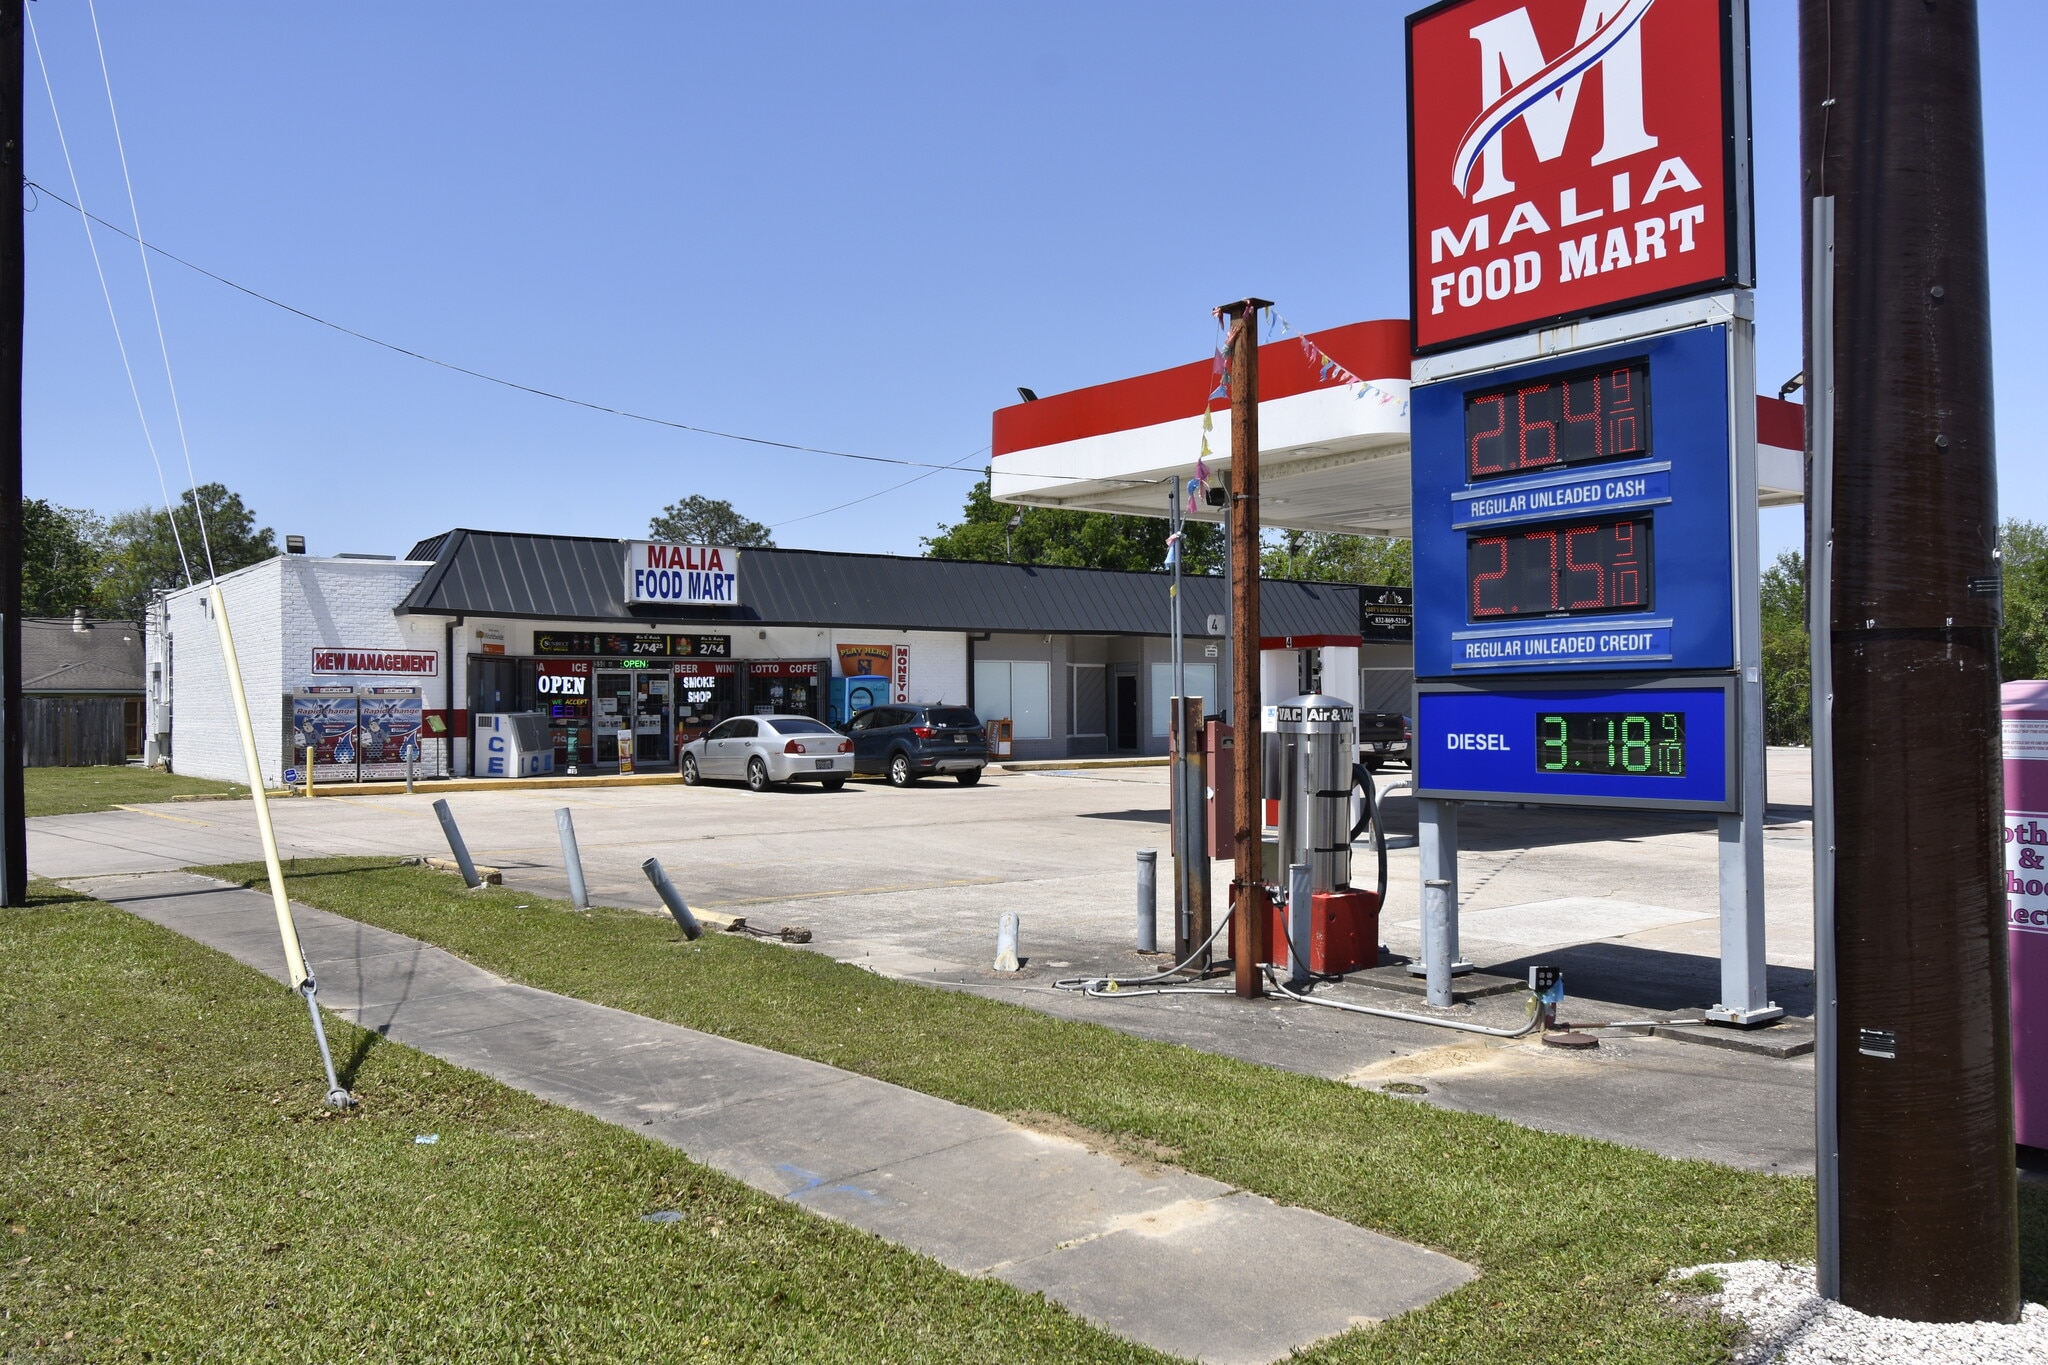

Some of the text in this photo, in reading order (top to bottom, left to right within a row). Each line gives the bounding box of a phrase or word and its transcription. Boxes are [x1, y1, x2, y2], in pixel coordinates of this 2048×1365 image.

[1431, 156, 1702, 264] MALIA
[1431, 204, 1704, 315] FOOD MART
[1471, 479, 1646, 517] REGULAR UNLEADED CASH
[647, 545, 724, 571] MALIA
[635, 569, 735, 601] FOOD MART
[1211, 618, 1218, 631] 4
[1286, 637, 1292, 647] 4
[1466, 634, 1653, 658] REGULAR UNLEADED CREDIT
[315, 652, 435, 672] NEW MANAGEMENT
[572, 663, 588, 672] ICE
[624, 660, 646, 668] OPEN
[674, 665, 698, 674] BEER
[715, 665, 735, 674] WIN
[750, 664, 780, 673] LOTTO
[897, 648, 907, 691] MONEY
[538, 675, 586, 695] OPEN
[683, 676, 715, 689] SMOKE
[687, 691, 712, 703] SHOP
[1278, 708, 1302, 721] VAC
[1307, 708, 1330, 721] Air
[1331, 708, 1341, 721] &
[1447, 733, 1510, 750] DIESEL
[521, 754, 552, 774] ICE
[2018, 847, 2044, 869] &
